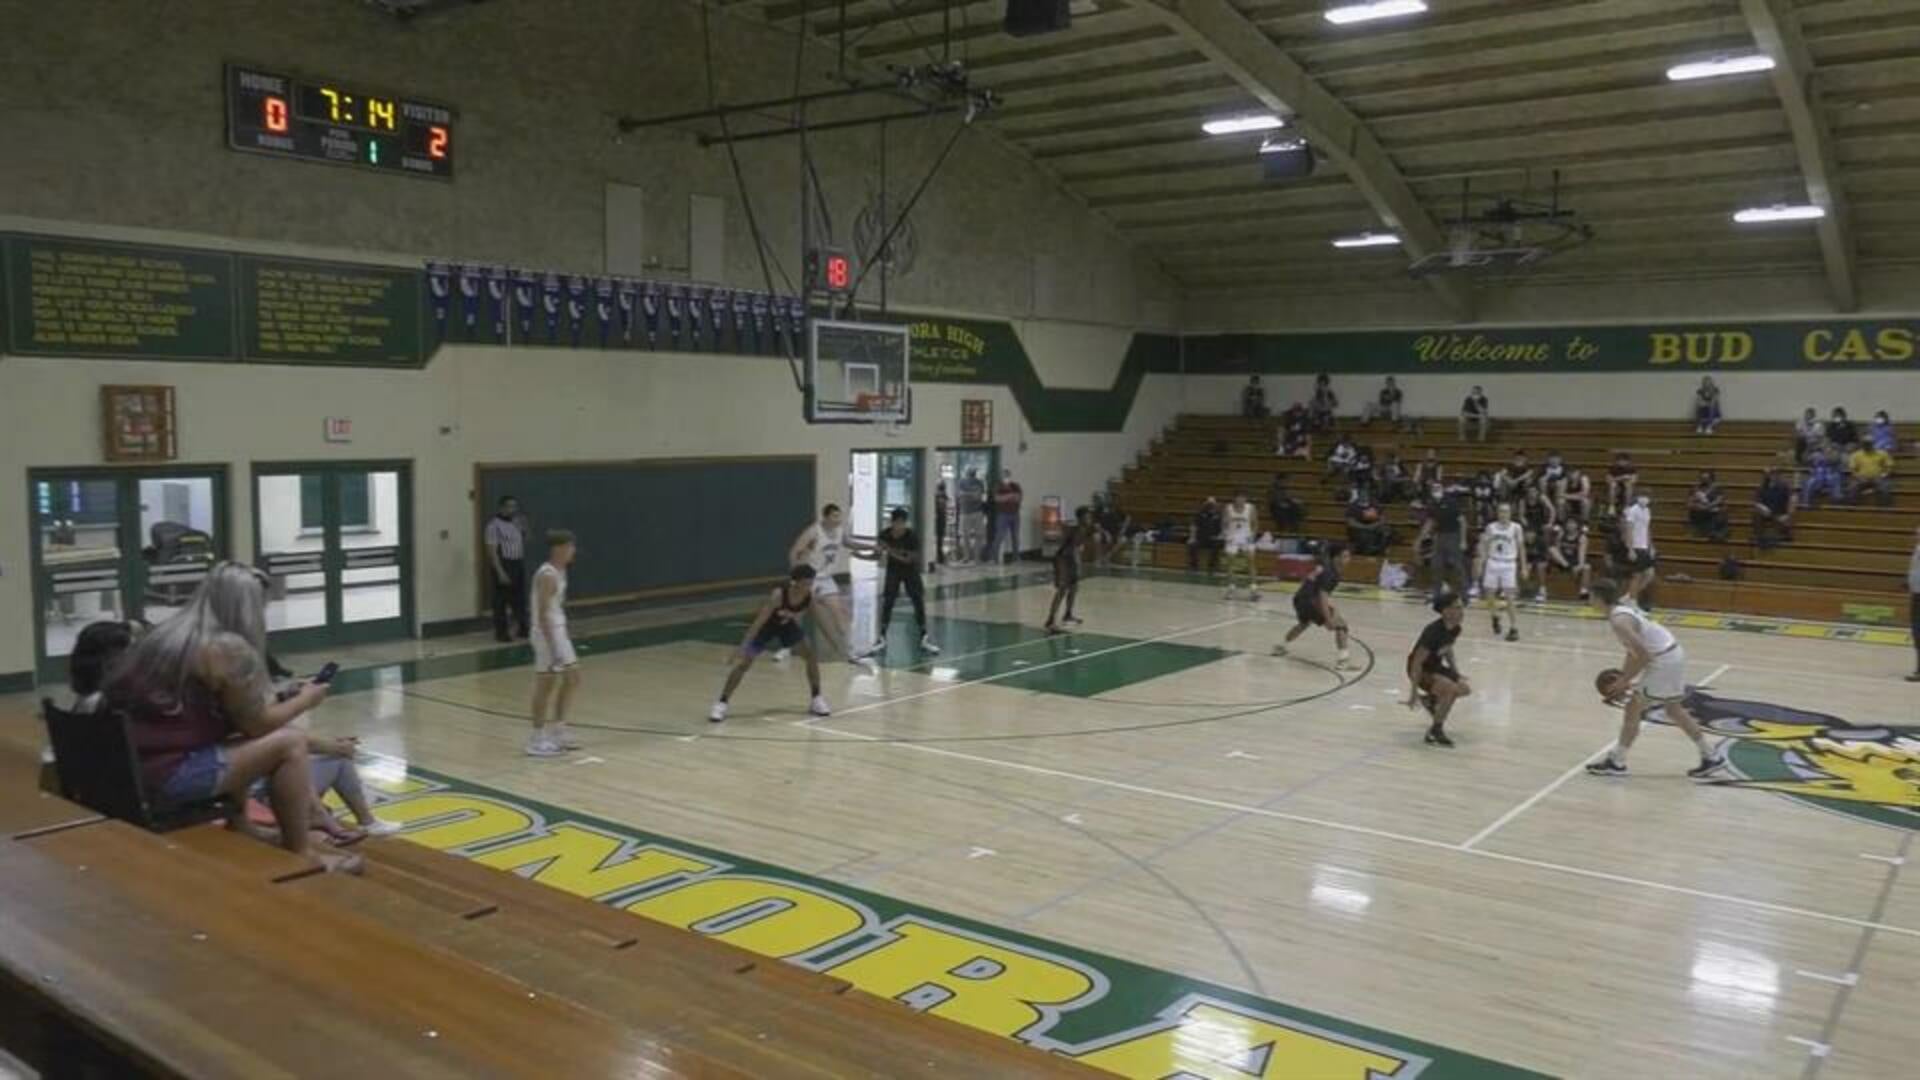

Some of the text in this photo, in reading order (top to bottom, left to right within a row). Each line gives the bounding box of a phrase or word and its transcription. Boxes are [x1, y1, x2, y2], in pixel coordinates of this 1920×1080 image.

[265, 96, 288, 131] 0
[320, 88, 394, 130] 7:14
[369, 140, 378, 164] 1
[429, 126, 448, 158] 2
[829, 258, 848, 287] 18
[946, 325, 985, 355] HIGH
[1414, 328, 1920, 364] Welcome to BUD CAS
[318, 762, 1433, 1080] ONORA
